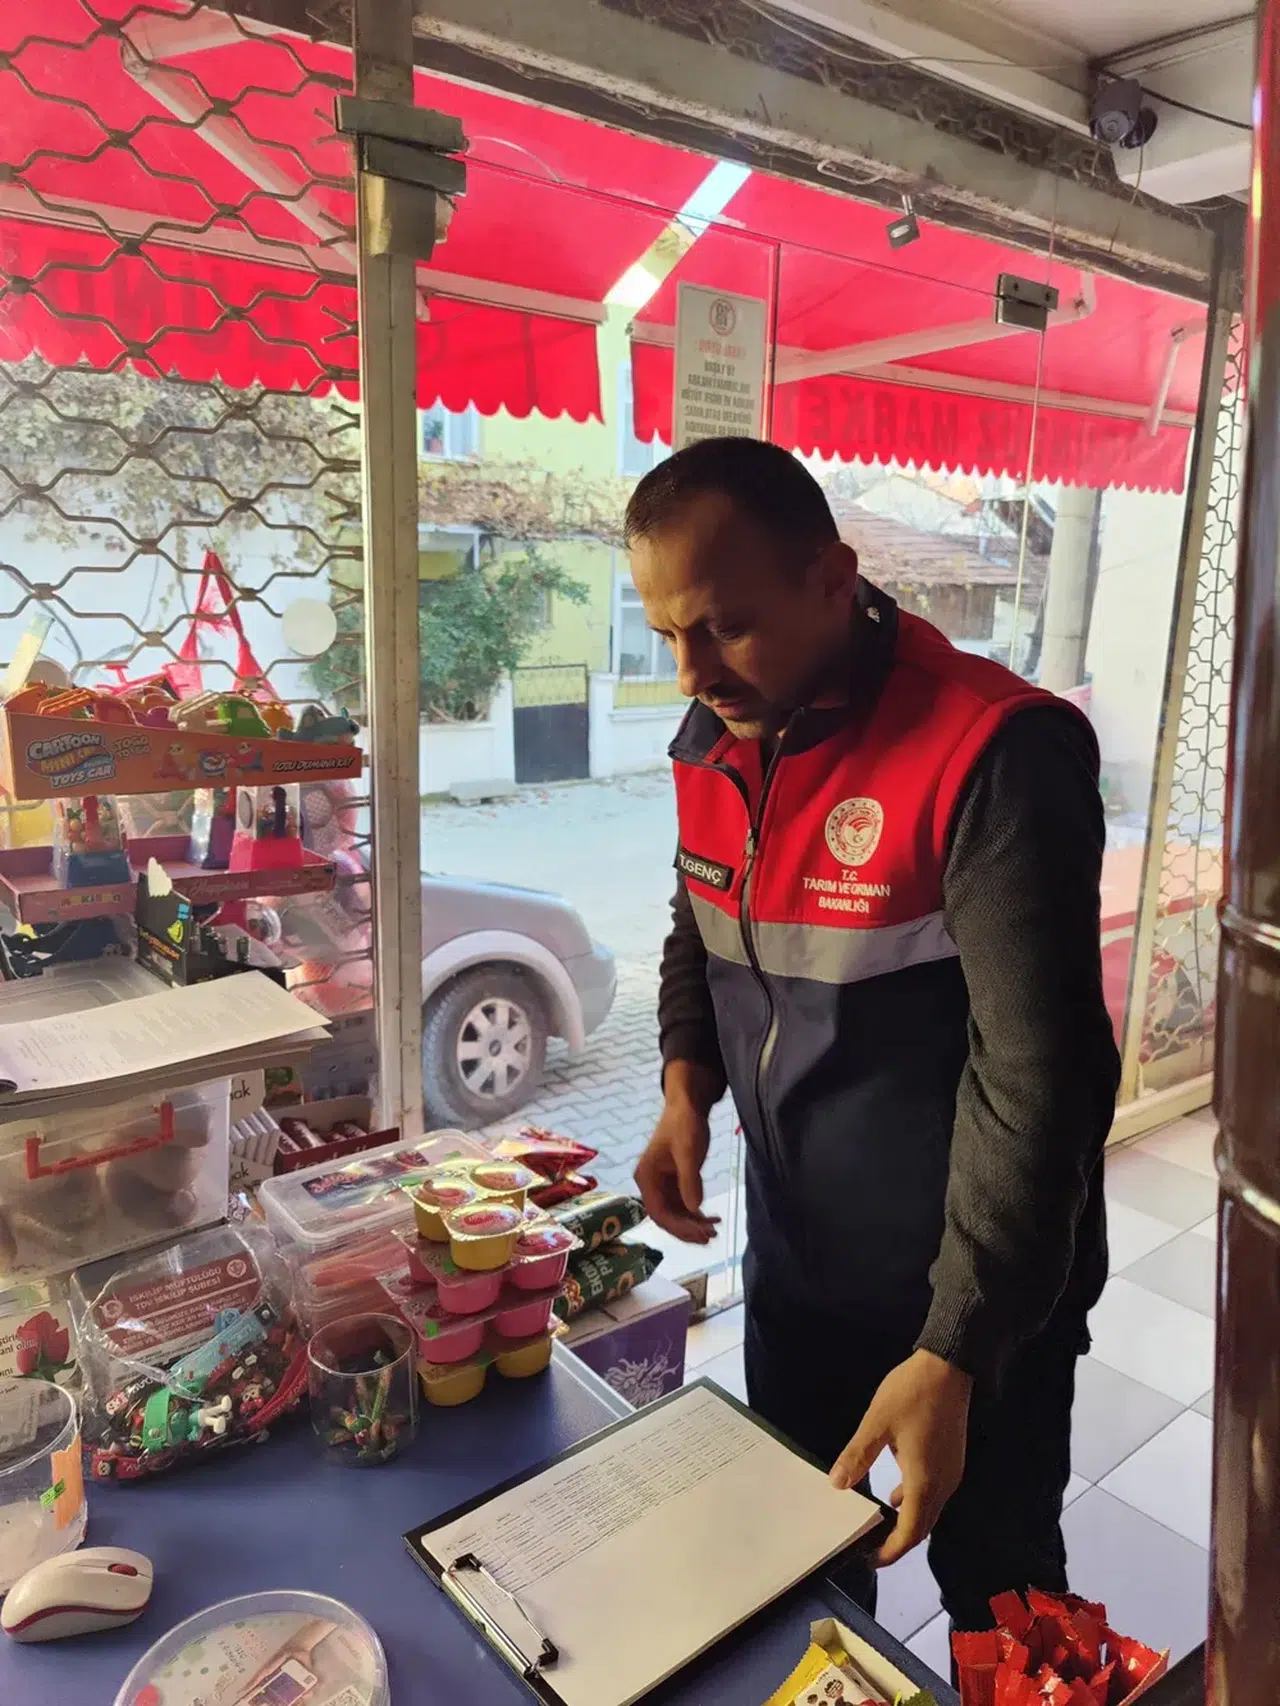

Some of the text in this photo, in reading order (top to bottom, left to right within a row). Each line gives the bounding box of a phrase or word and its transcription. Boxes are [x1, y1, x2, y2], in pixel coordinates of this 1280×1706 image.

[28, 734, 101, 760] CARTOON
[53, 770, 85, 786] TOYS
[679, 853, 722, 885] T.GENÇ
[803, 877, 837, 893] TARIM
[850, 882, 890, 897] ORMAN
[818, 896, 870, 913] BAKANLIĞI
